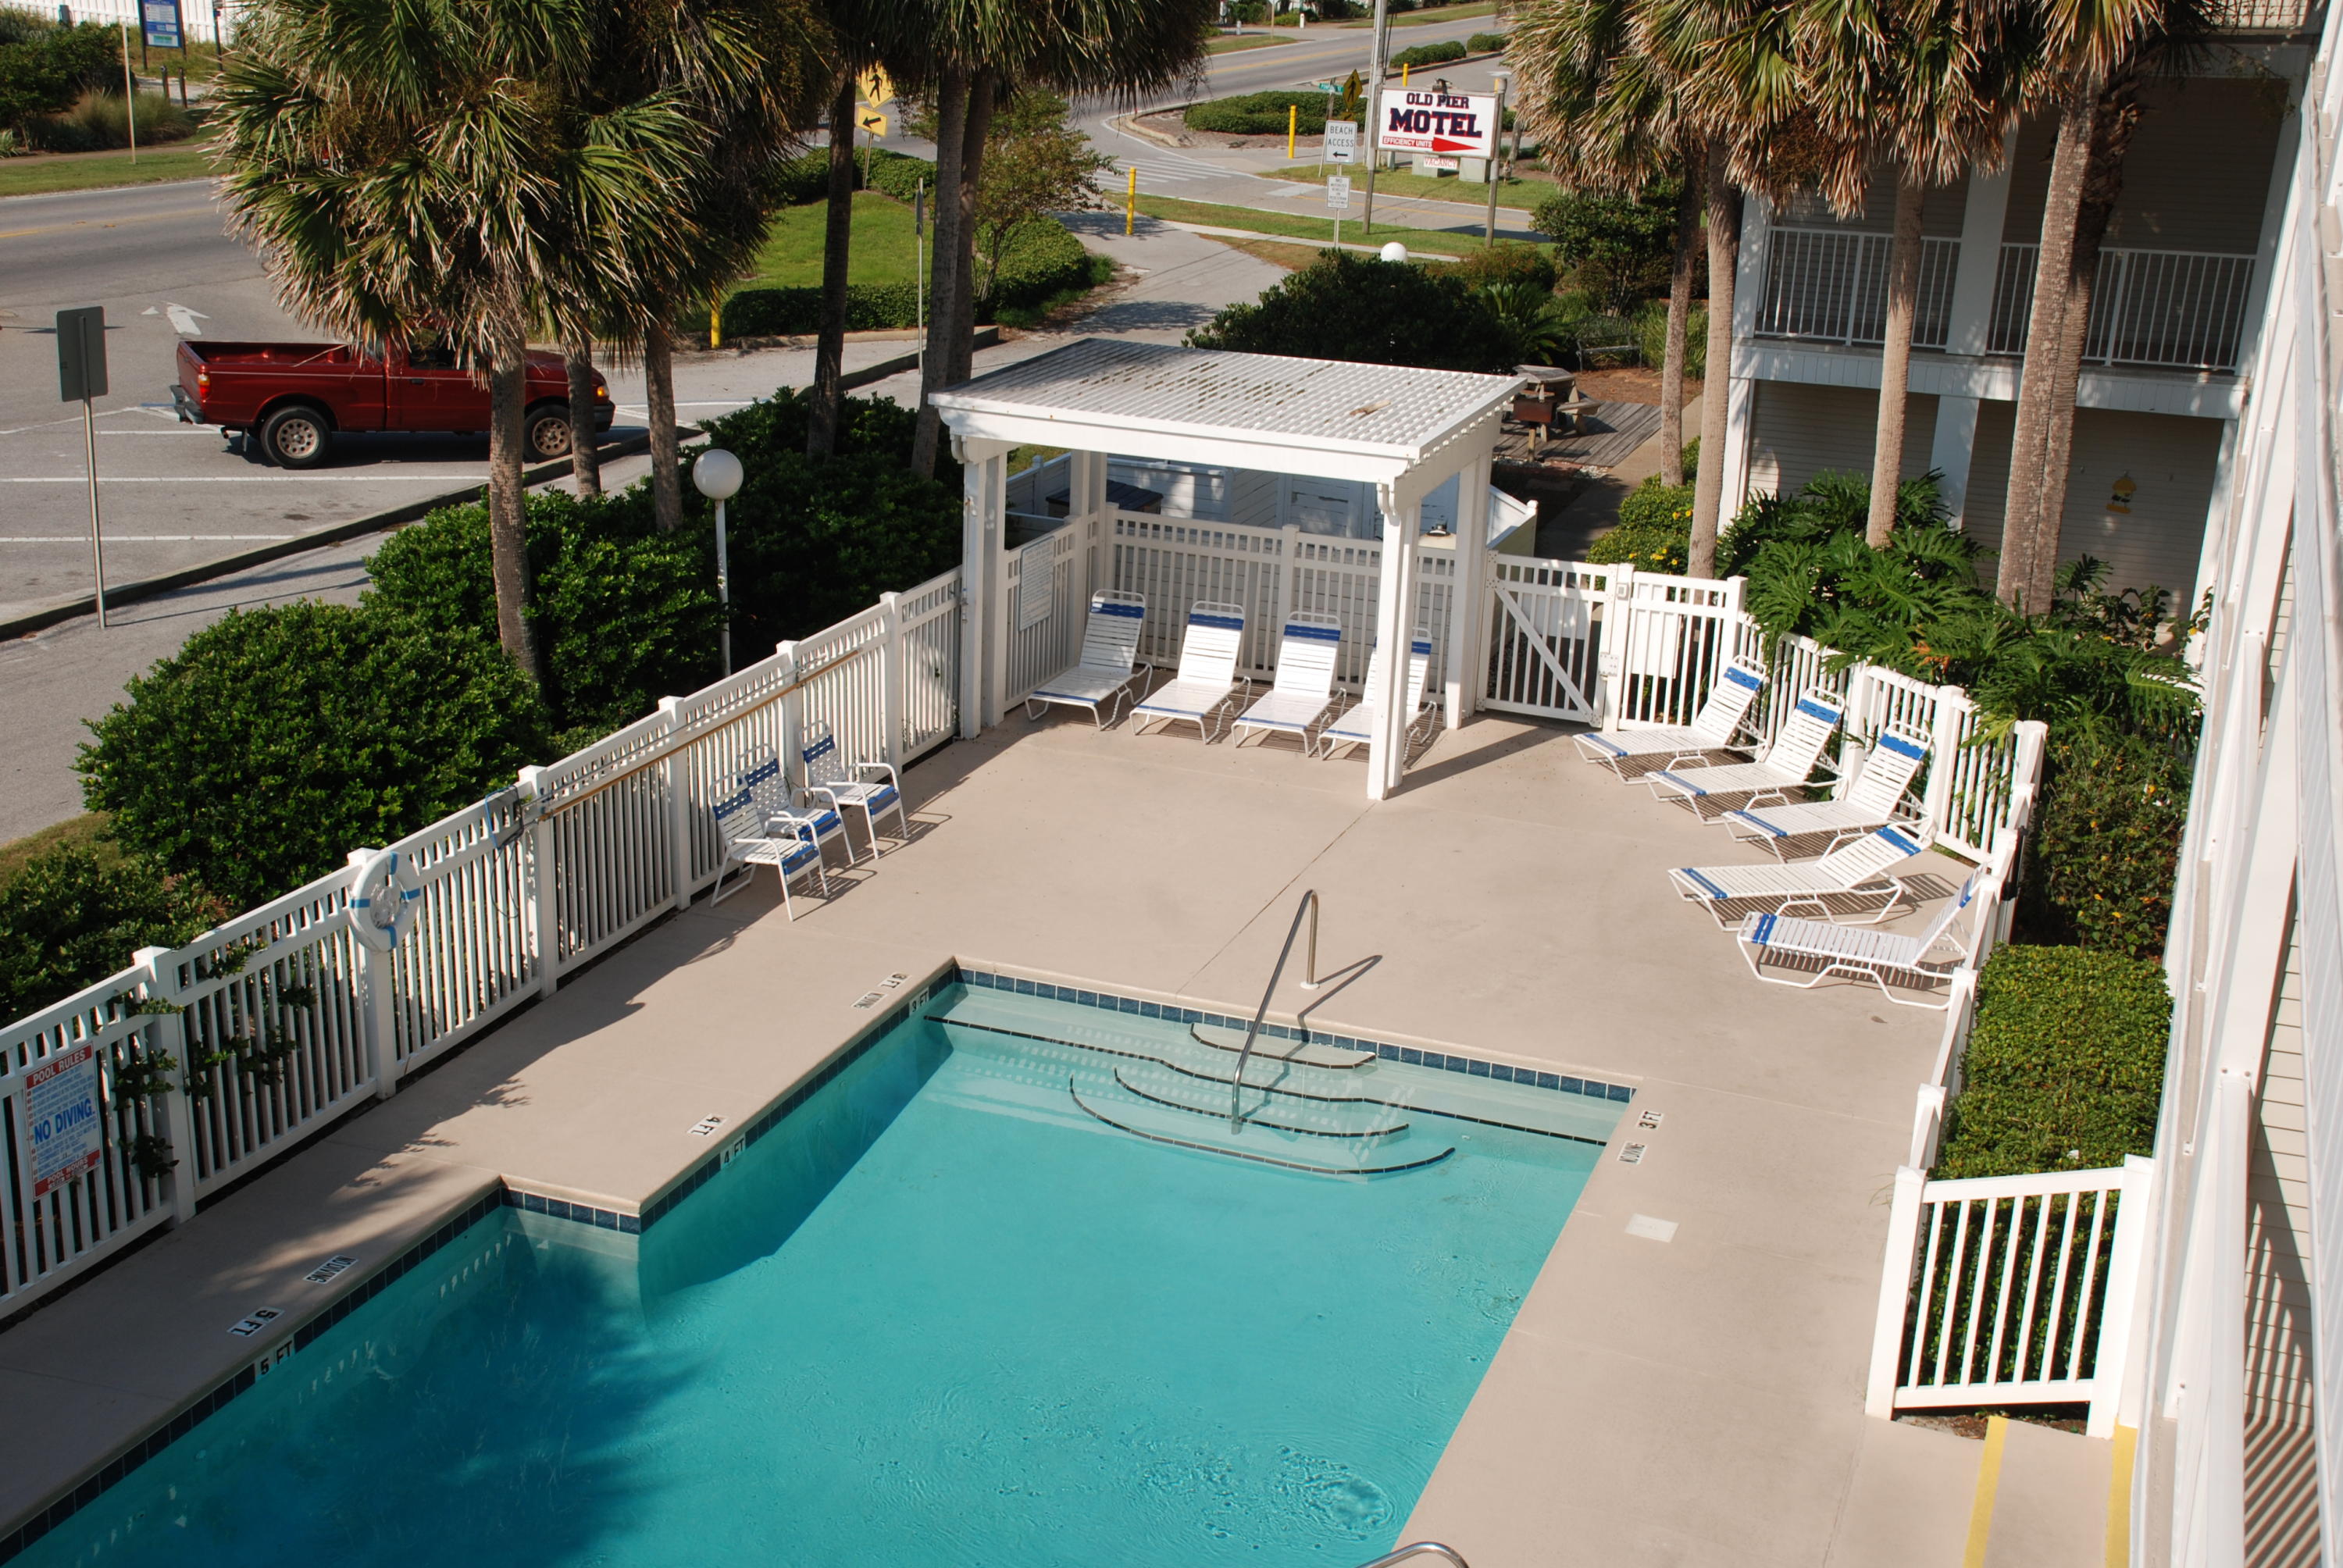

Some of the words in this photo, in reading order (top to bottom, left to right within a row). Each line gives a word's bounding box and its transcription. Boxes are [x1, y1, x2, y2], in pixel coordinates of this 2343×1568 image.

[1407, 92, 1432, 106] OLD
[1436, 94, 1469, 109] PIER
[1330, 126, 1353, 135] BEACH
[1389, 107, 1482, 138] MOTEL
[1328, 138, 1354, 148] ACCESS
[1383, 136, 1415, 147] EFFICIENCY
[1416, 139, 1432, 148] UNITS
[1424, 156, 1458, 168] VACANCY
[919, 989, 929, 1007] FT
[33, 1065, 56, 1085] POOL
[59, 1049, 86, 1073] RULES
[34, 1119, 51, 1145] NO
[55, 1098, 95, 1134] DIVING.
[1642, 1110, 1662, 1122] FT
[690, 1124, 715, 1135] FT
[724, 1150, 729, 1164] 4
[734, 1138, 744, 1156] FT
[47, 1171, 64, 1184] POOL
[66, 1156, 88, 1173] HOURS
[255, 1310, 279, 1321] 5
[230, 1320, 263, 1336] FT
[260, 1358, 269, 1375] 5
[276, 1340, 293, 1365] FT
